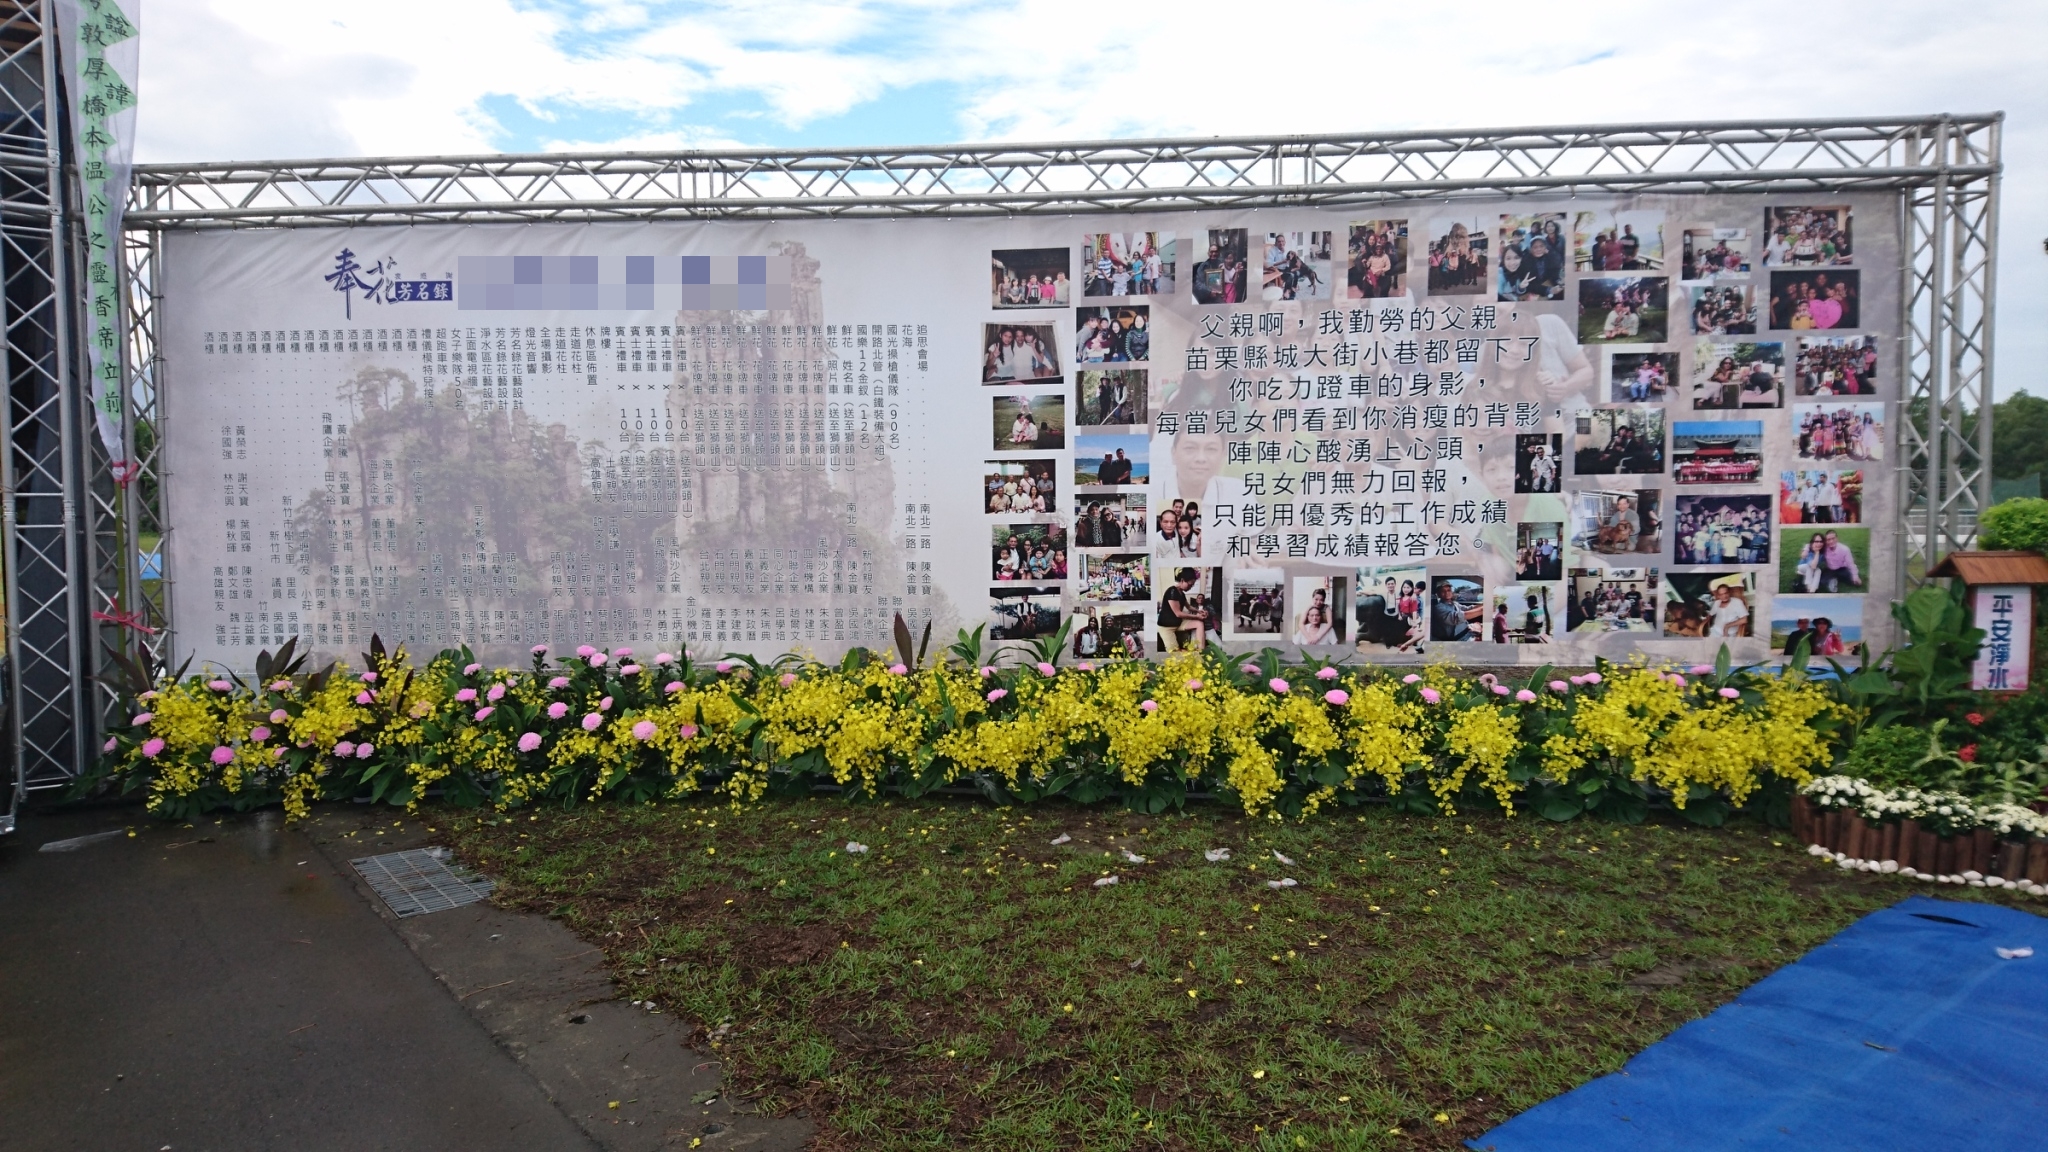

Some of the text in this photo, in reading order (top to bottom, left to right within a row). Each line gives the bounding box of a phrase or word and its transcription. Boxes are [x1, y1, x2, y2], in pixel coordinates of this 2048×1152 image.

[398, 282, 449, 300] 芳名錄
[1200, 305, 1521, 340] 父親啊，我勤勞的父親，
[916, 325, 928, 372] 追思會場
[1185, 335, 1541, 372] 苗栗縣城大街小巷都留下了
[1228, 371, 1488, 403] 你吃力蹬車的身影，
[1156, 402, 1563, 437] 每當兒女們看到你消瘦的背影，
[1227, 435, 1485, 466] 陣陣心酸湧上心頭，
[1243, 467, 1469, 497] 兒女們無力回報，
[1213, 500, 1508, 529] 只能用優秀的工作成績
[1226, 531, 1485, 560] 和學習成績報答您。
[1988, 594, 2014, 689] 平安淨水
